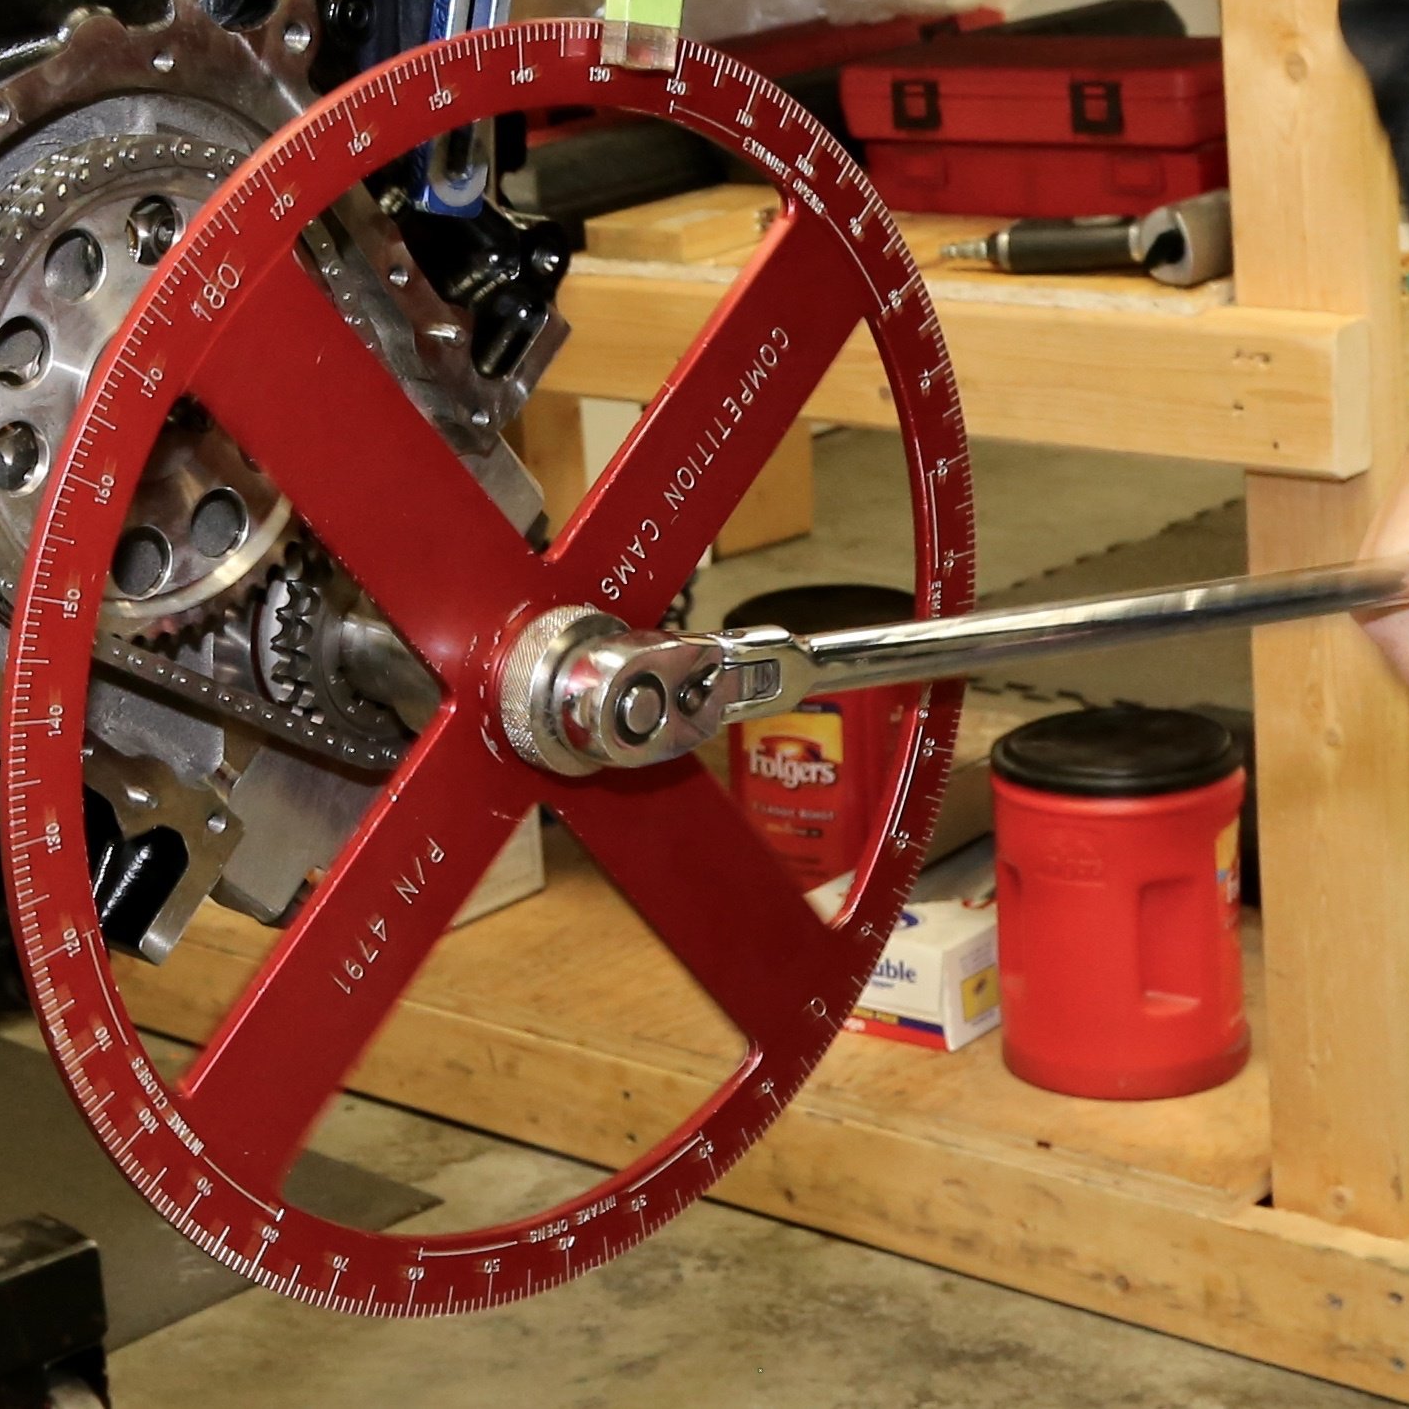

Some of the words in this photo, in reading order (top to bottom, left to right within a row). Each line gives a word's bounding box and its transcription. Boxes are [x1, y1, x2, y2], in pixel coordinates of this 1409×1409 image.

[510, 67, 534, 85] 140
[588, 67, 610, 83] 130
[666, 79, 686, 96] 120
[428, 89, 452, 110] 150
[735, 108, 754, 128] 110
[347, 130, 371, 157] 160
[742, 136, 792, 181] EXHAUST
[793, 178, 827, 215] OPENS
[794, 153, 815, 178] 100
[270, 193, 295, 221] 170
[189, 261, 241, 322] 180
[140, 367, 164, 398] 170
[662, 326, 790, 511] COMPETITION
[93, 473, 116, 505] 160
[602, 516, 660, 602] CAMS
[62, 588, 81, 621] 150
[46, 703, 64, 737] 140
[749, 744, 836, 788] Folgers
[391, 837, 445, 905] P/N
[62, 927, 81, 958] 120
[330, 917, 387, 996] 4791
[94, 1026, 113, 1052] 110
[132, 1057, 169, 1110] CLOSES
[138, 1107, 160, 1135] 100
[167, 1112, 206, 1157] INTAKE
[195, 1177, 213, 1197] 90
[576, 1196, 617, 1228] INTAKE
[261, 1225, 280, 1243] 80
[529, 1217, 569, 1244] OPENS
[332, 1255, 348, 1272] 70
[407, 1266, 425, 1281] 60
[483, 1259, 501, 1275] 50
